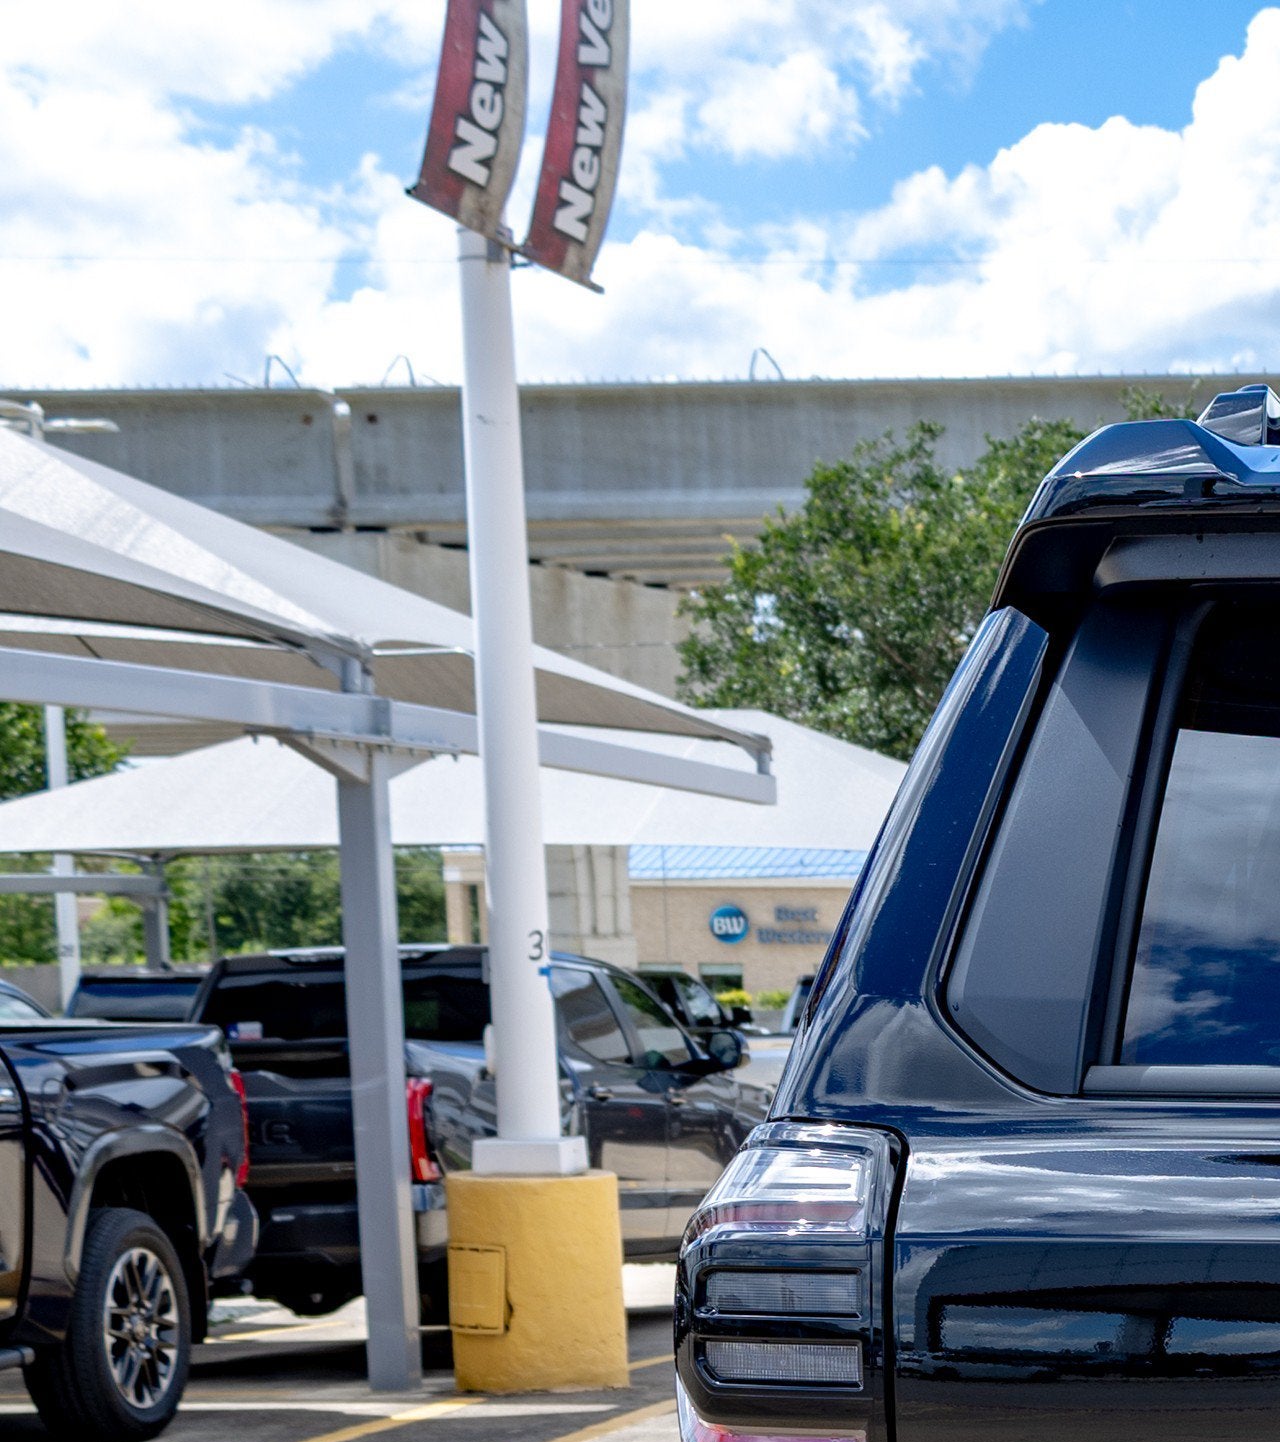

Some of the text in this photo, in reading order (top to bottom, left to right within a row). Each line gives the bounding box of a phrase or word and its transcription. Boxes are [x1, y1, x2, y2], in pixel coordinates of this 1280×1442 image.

[449, 13, 509, 187] New
[554, 85, 608, 243] New
[713, 917, 745, 935] BW
